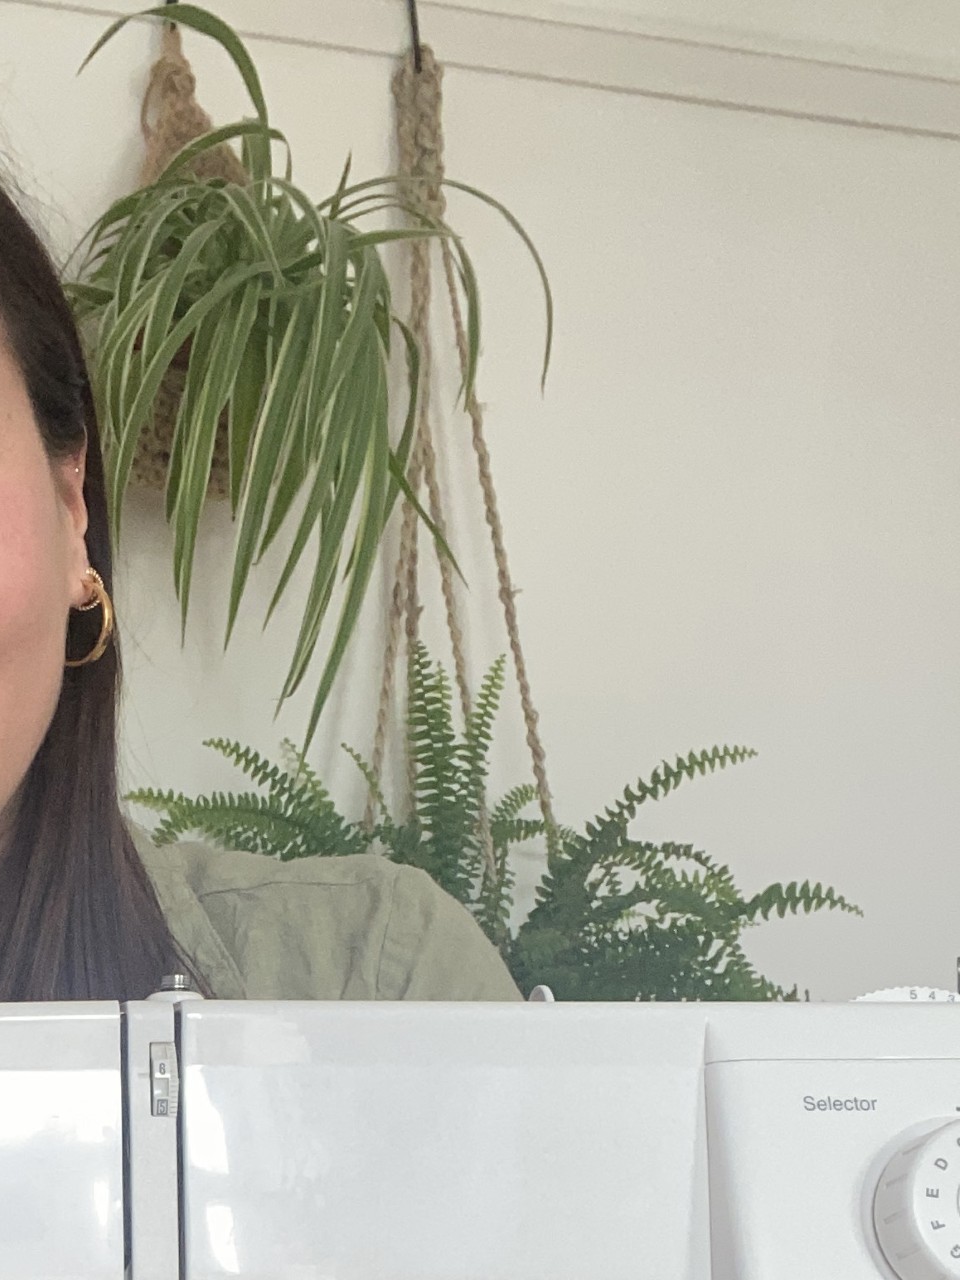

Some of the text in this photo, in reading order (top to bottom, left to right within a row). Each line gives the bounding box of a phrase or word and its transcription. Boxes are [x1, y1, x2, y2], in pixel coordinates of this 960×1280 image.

[910, 989, 918, 1000] 5
[928, 990, 936, 1000] 4
[802, 1095, 878, 1112] Selector
[933, 1157, 948, 1171] D
[925, 1187, 940, 1199] E
[930, 1219, 946, 1231] F
